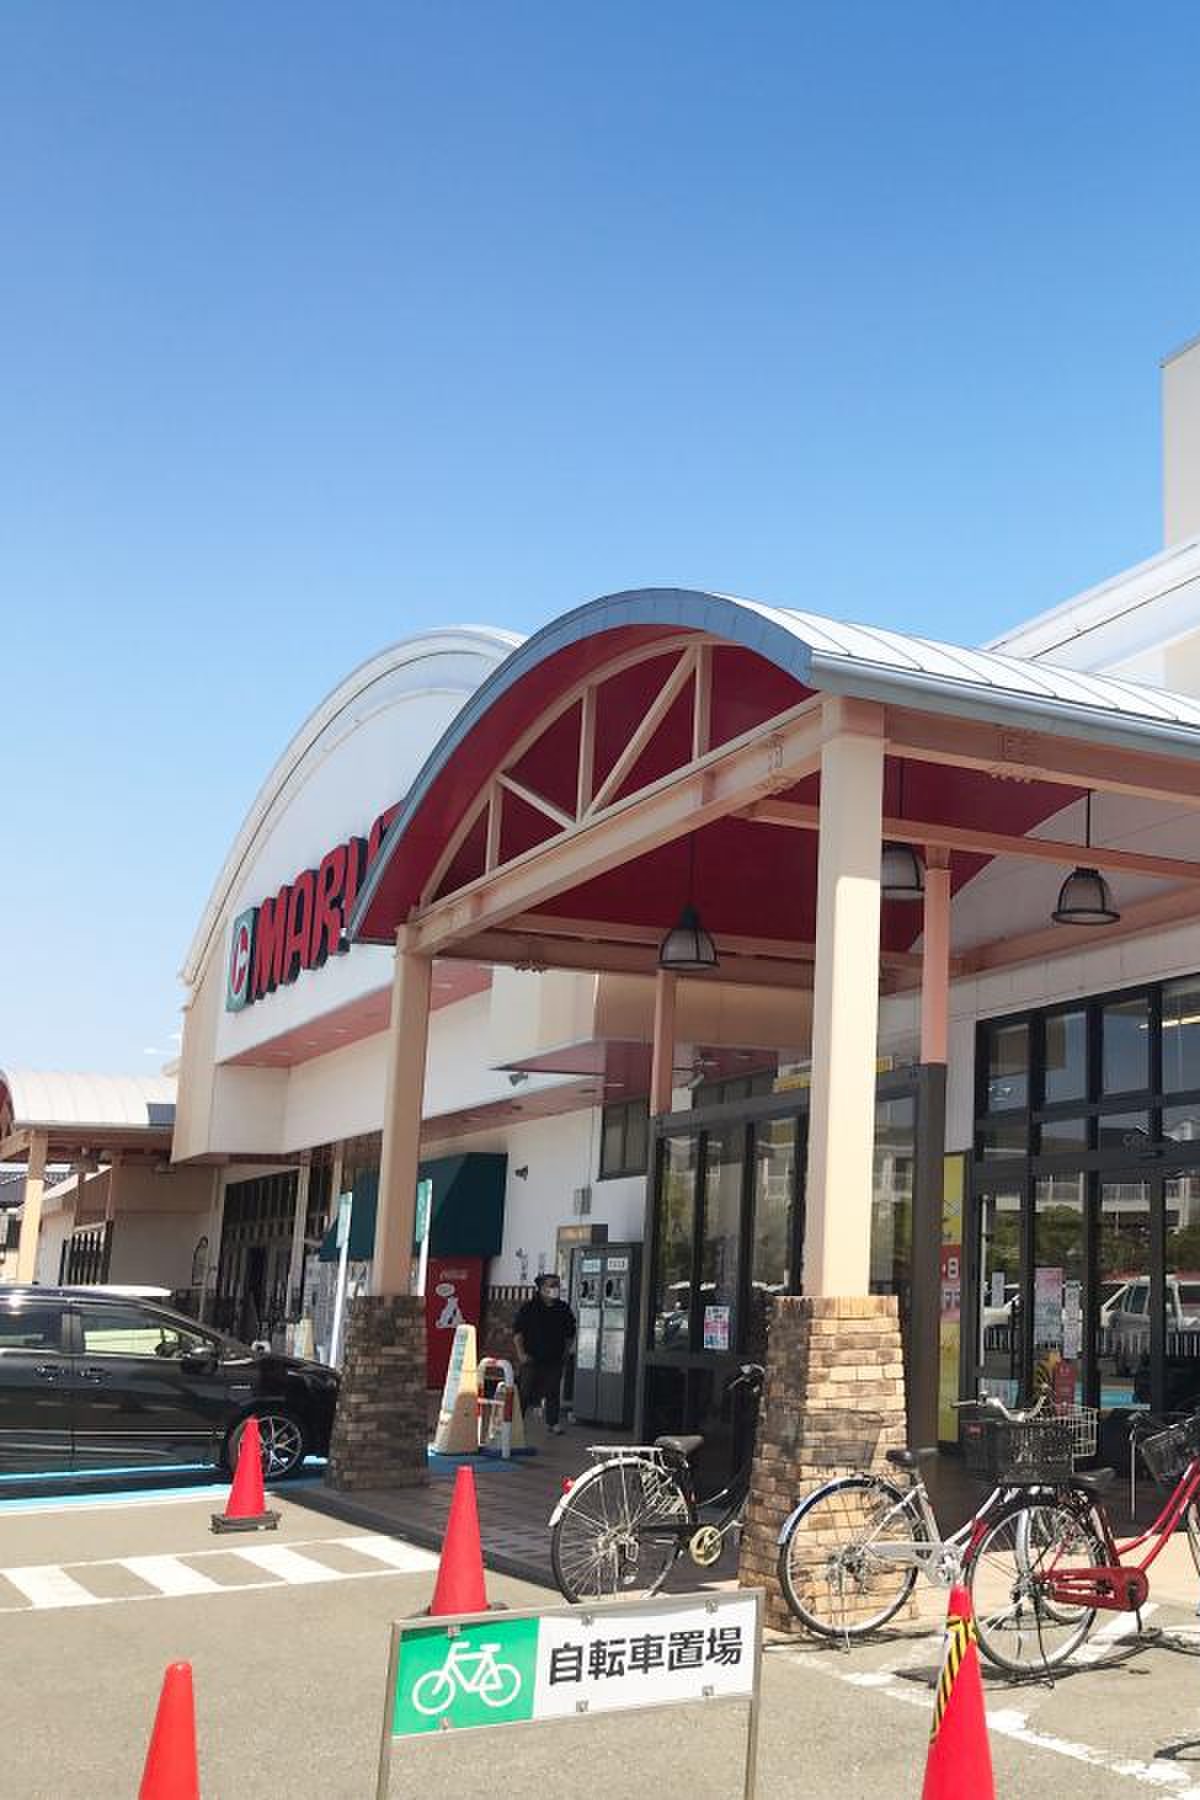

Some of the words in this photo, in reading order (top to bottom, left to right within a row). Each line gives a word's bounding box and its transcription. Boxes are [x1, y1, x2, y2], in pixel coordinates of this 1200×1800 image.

[548, 1625, 742, 1686] 自転車置場
